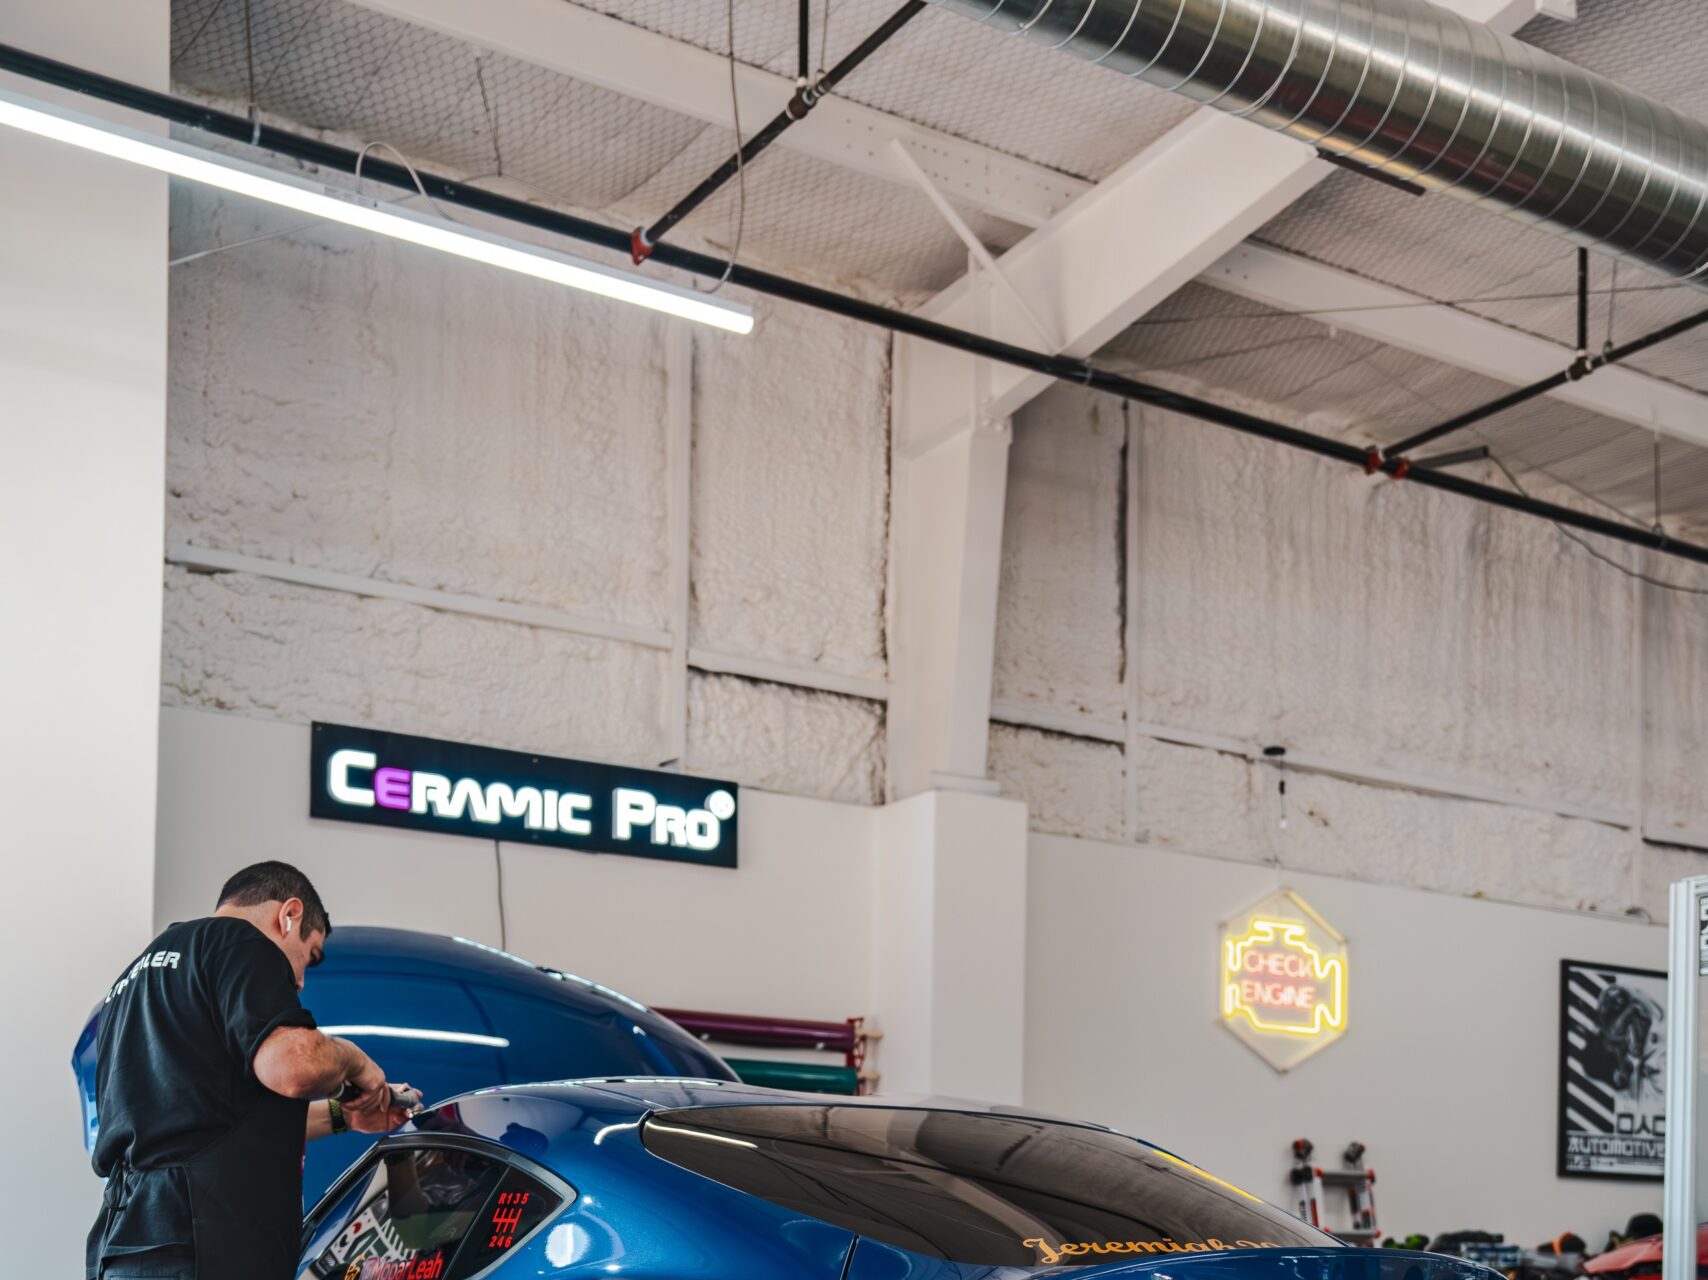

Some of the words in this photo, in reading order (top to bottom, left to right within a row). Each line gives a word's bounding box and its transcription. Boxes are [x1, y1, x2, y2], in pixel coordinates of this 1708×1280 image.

[328, 749, 592, 835] CERAMIC
[612, 786, 721, 850] PRO
[1243, 950, 1315, 978] CHECK
[1241, 980, 1315, 1009] ENGINE
[1567, 1136, 1665, 1158] AUTOMOTIVE
[1023, 1237, 1233, 1264] Jeremiah
